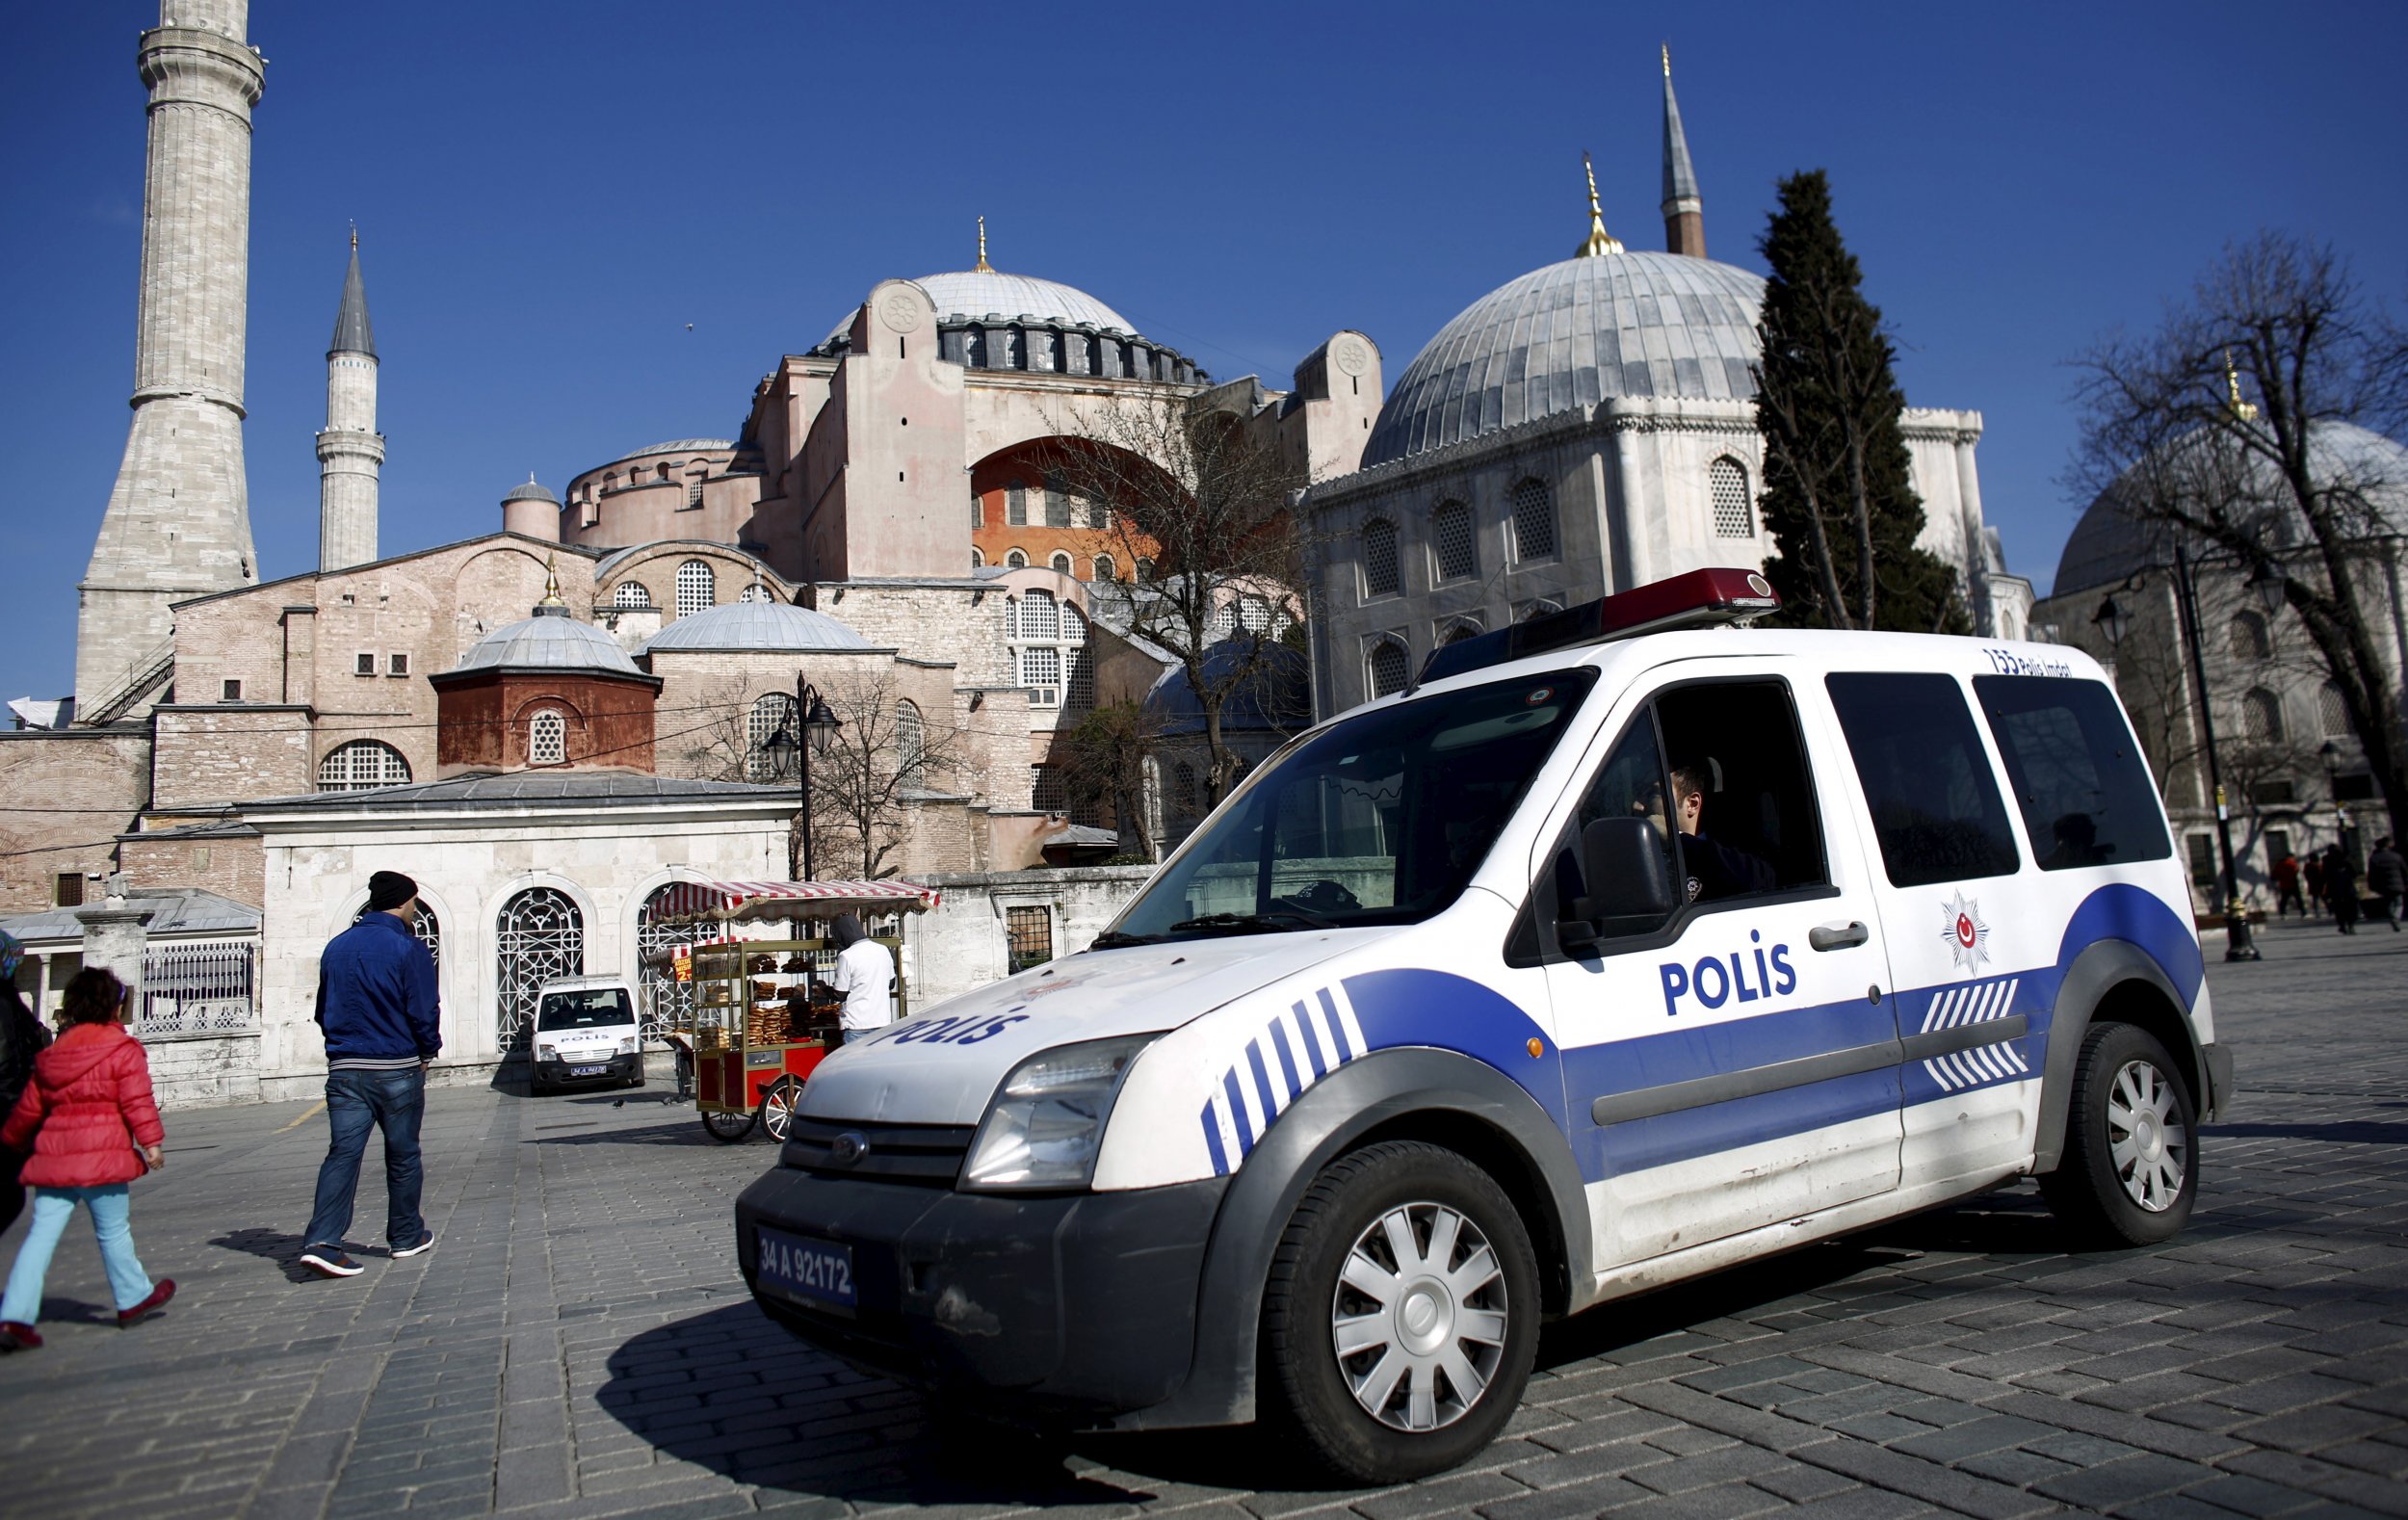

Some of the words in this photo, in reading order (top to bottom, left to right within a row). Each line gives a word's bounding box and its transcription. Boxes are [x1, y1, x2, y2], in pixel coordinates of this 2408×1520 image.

[1982, 648, 2019, 674] 155
[2019, 657, 2044, 676] Polis
[677, 971, 687, 981] 2
[1659, 929, 1797, 1016] POLİS
[561, 1034, 610, 1043] POLİS
[867, 1005, 1030, 1046] POLİS
[760, 1237, 777, 1273] 34
[781, 1244, 792, 1279] A
[794, 1247, 851, 1295] 92172
